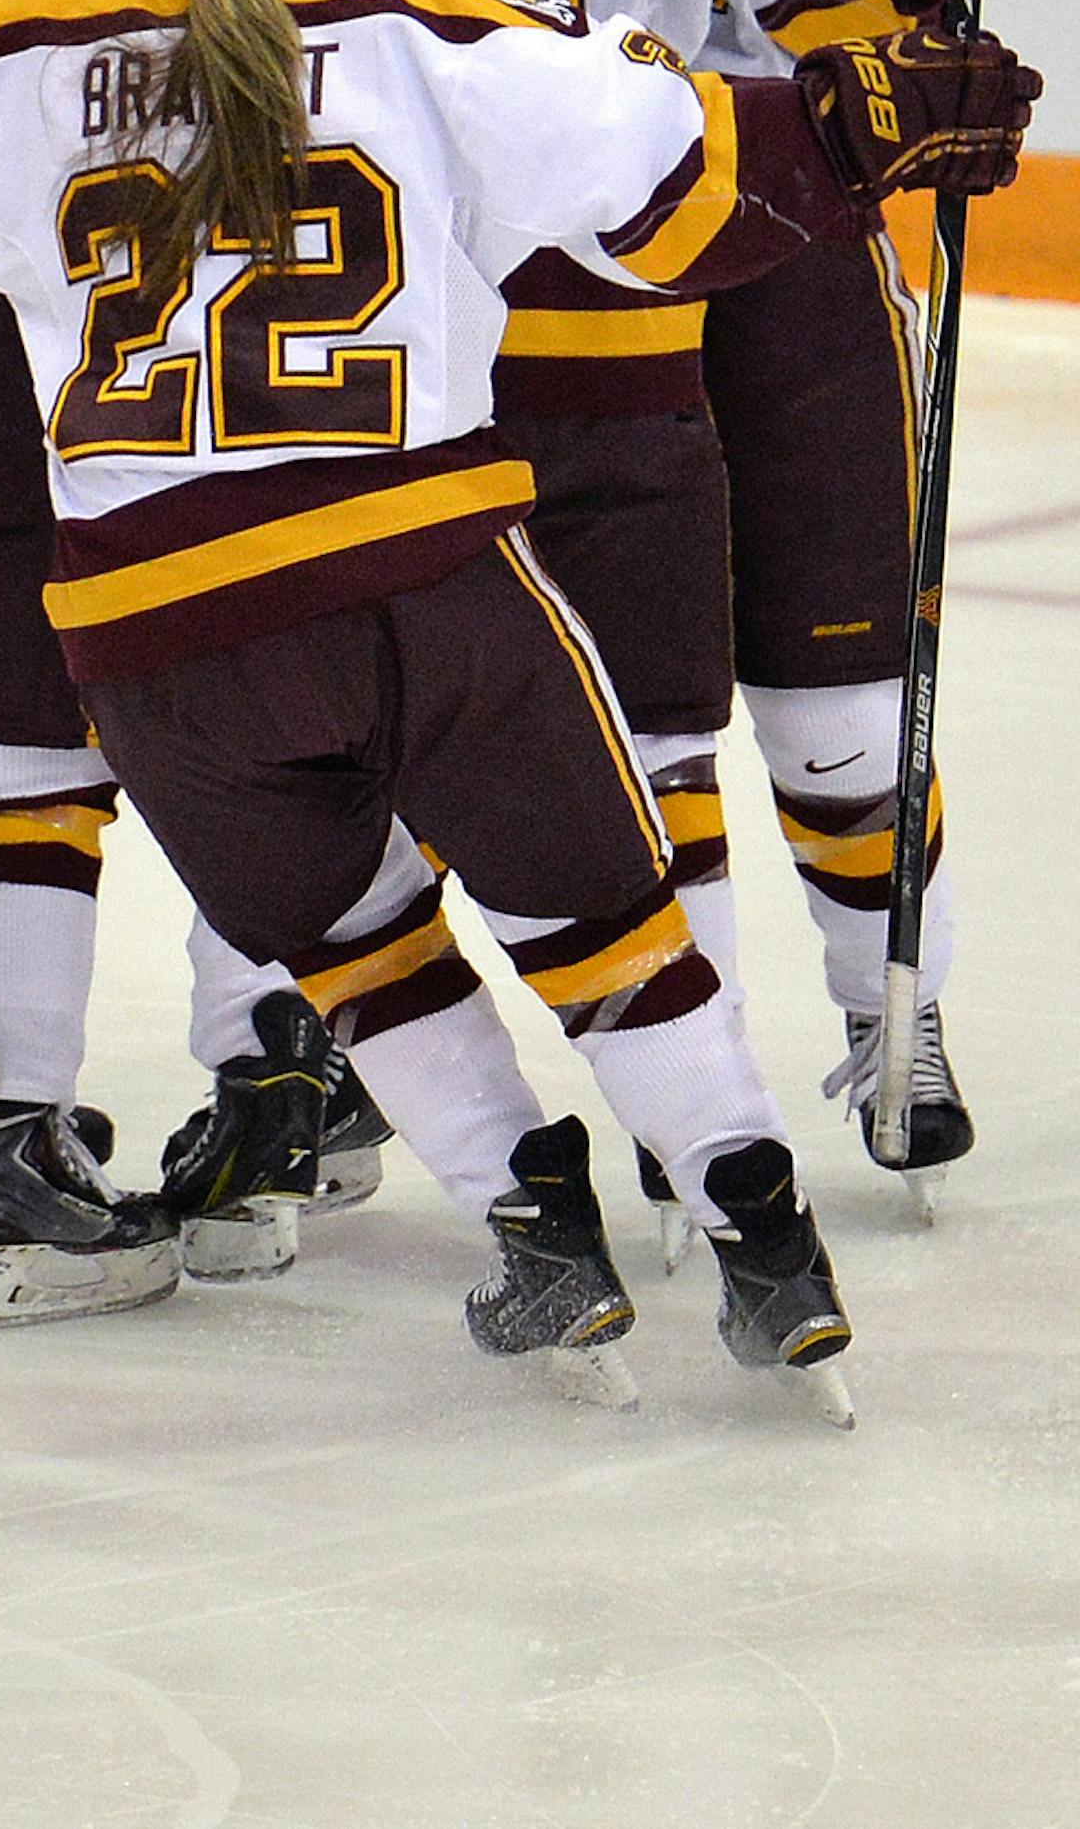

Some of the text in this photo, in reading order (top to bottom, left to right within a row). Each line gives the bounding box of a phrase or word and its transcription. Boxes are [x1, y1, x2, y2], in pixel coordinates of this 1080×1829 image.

[81, 42, 340, 138] BRAT
[830, 37, 901, 144] BAU
[46, 142, 407, 462] 22
[911, 672, 933, 773] BAUER
